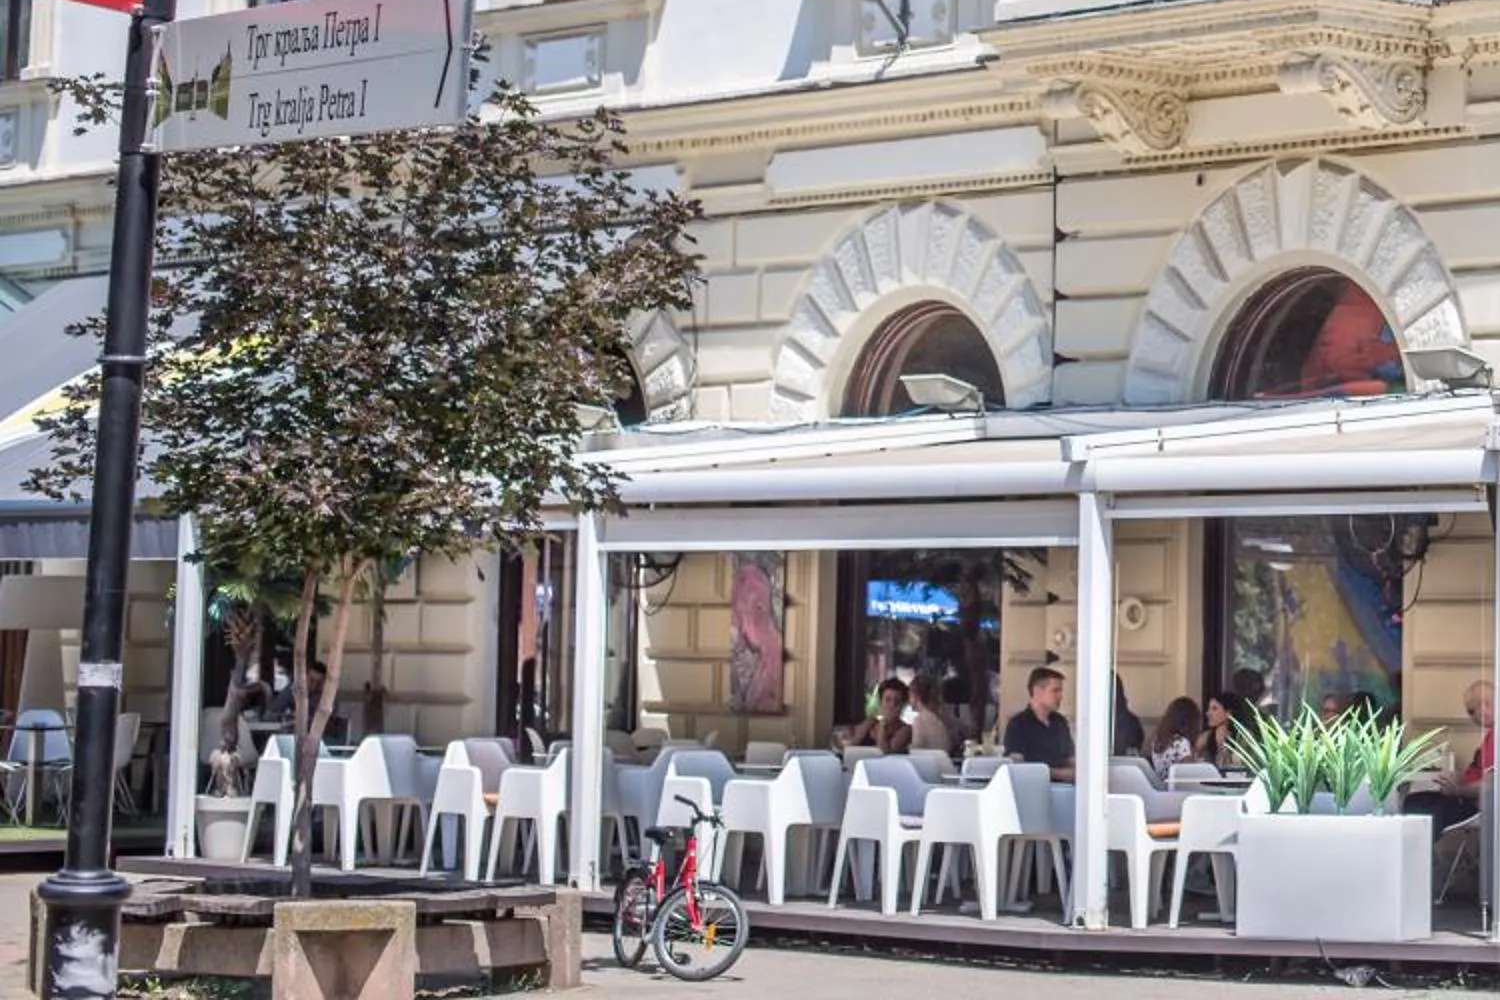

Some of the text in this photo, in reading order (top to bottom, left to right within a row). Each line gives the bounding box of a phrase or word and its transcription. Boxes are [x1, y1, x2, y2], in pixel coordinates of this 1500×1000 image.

[247, 24, 273, 70] Трг
[274, 25, 319, 66] краља
[323, 11, 370, 56] Петра
[249, 79, 368, 137] Trg kralja Petra I
